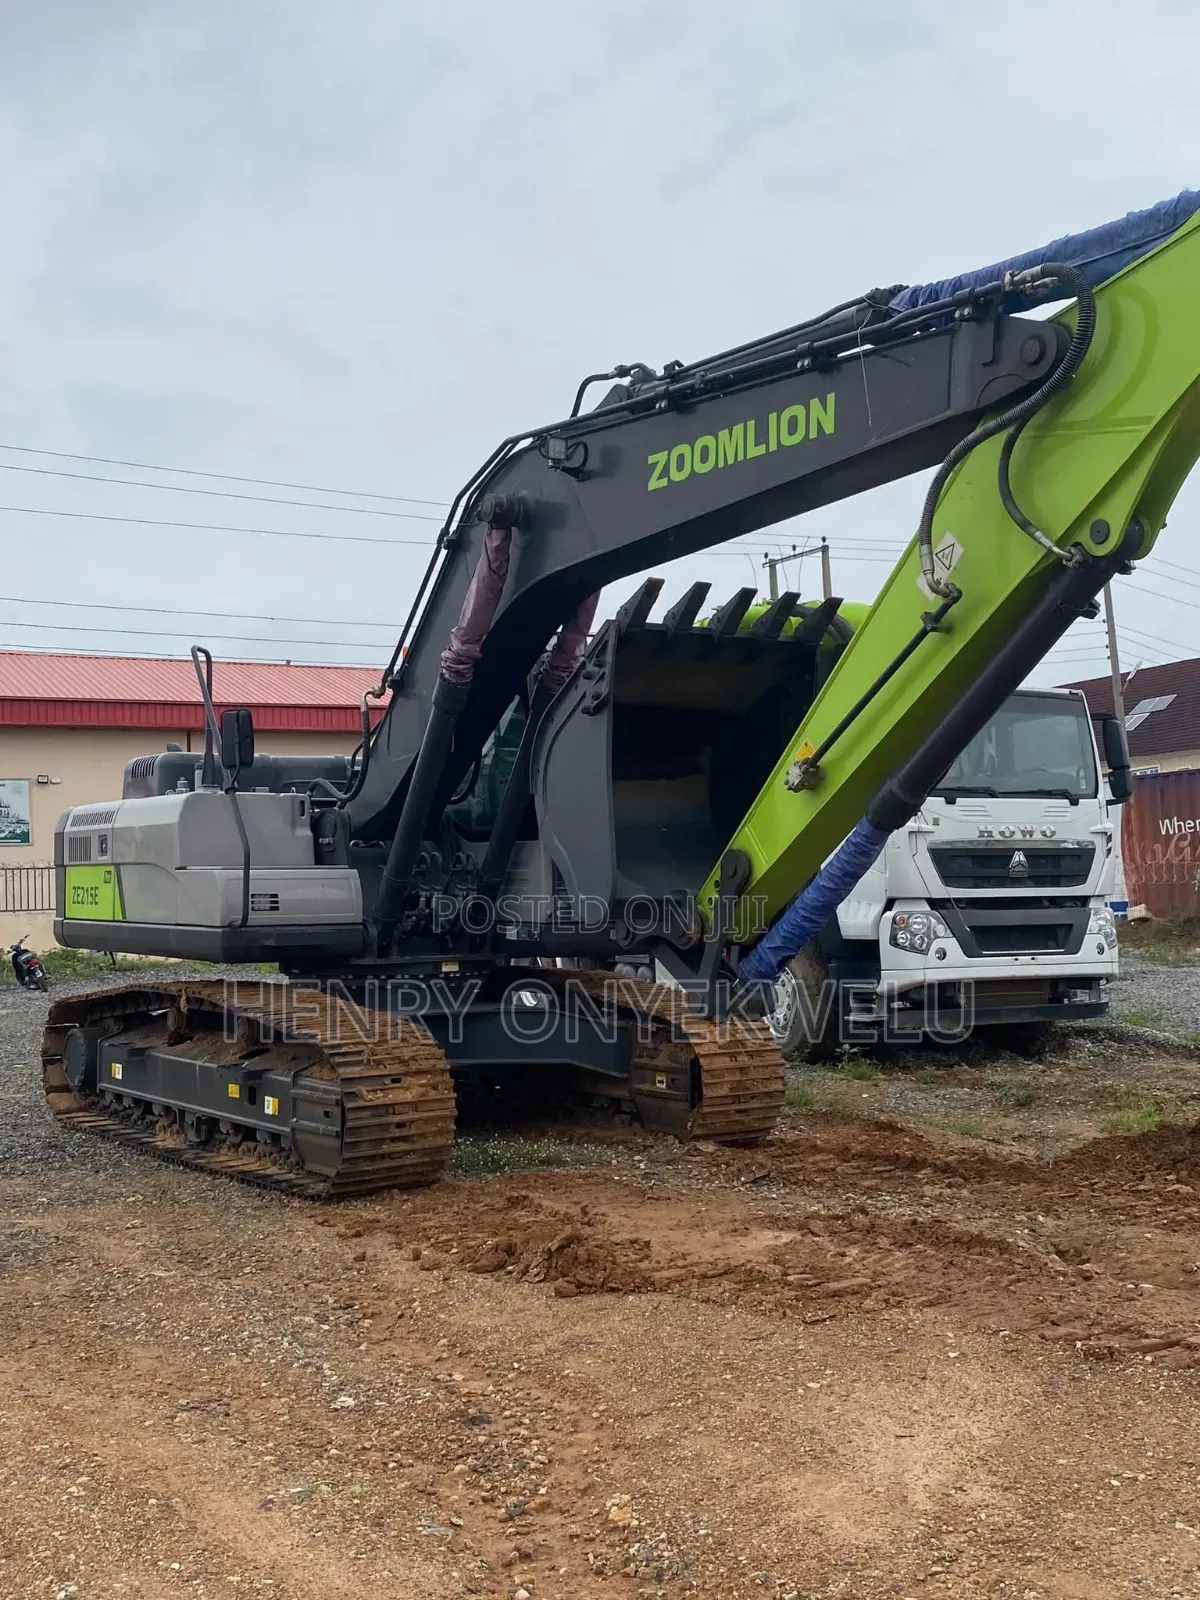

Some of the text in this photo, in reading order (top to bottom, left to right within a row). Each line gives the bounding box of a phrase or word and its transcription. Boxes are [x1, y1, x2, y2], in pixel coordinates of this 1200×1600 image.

[647, 391, 836, 491] ZOOMLION
[977, 825, 1057, 838] HOWO
[72, 885, 99, 906] ZE215E
